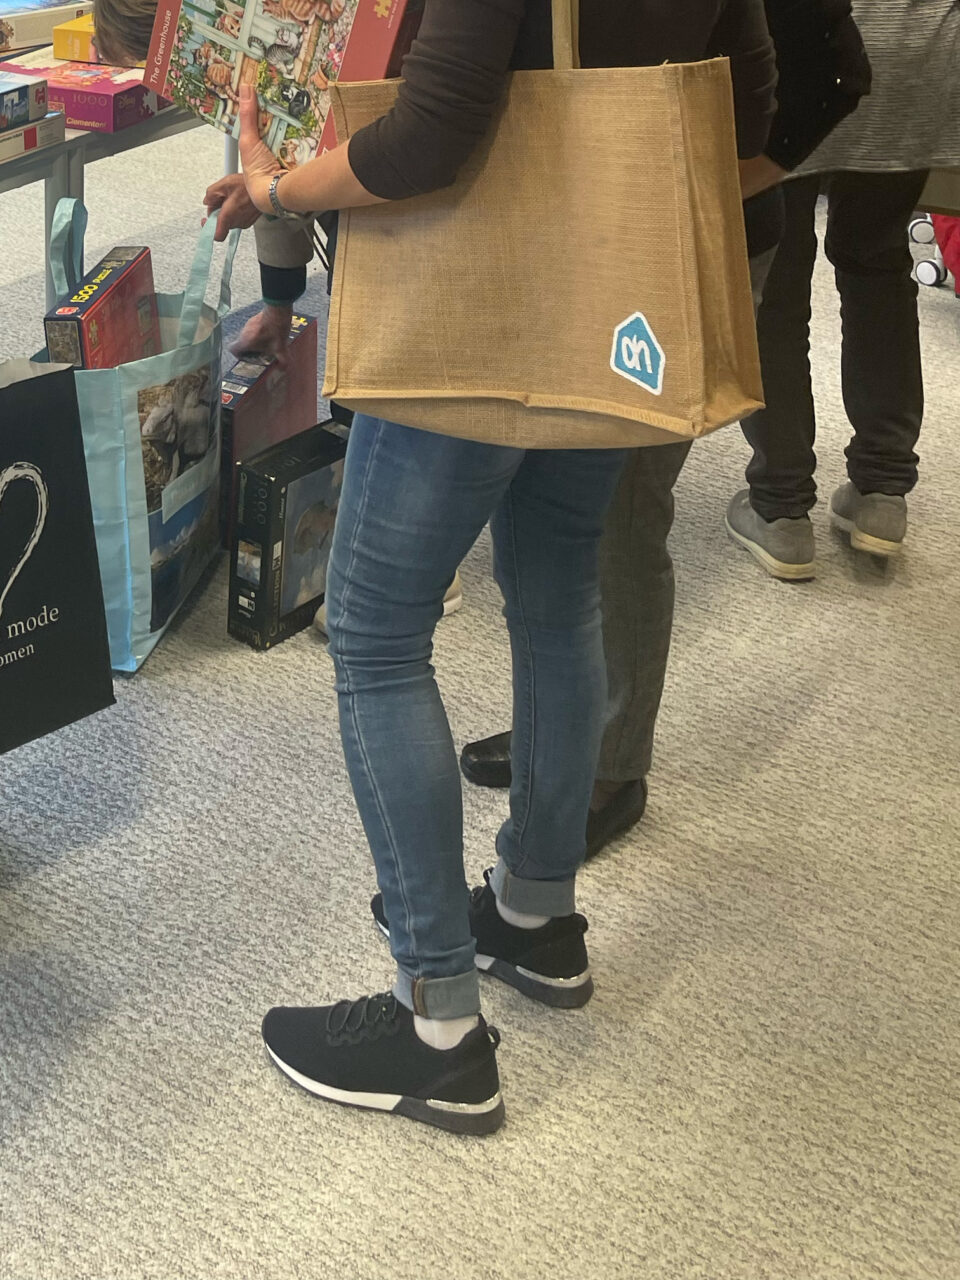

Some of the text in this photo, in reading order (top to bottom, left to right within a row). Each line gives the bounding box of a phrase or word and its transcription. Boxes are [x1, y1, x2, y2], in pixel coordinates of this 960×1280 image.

[150, 10, 172, 84] The Greenhouse
[73, 93, 107, 106] 1000
[66, 117, 107, 128] Clementoni
[69, 284, 98, 303] 1500
[6, 605, 60, 639] mode
